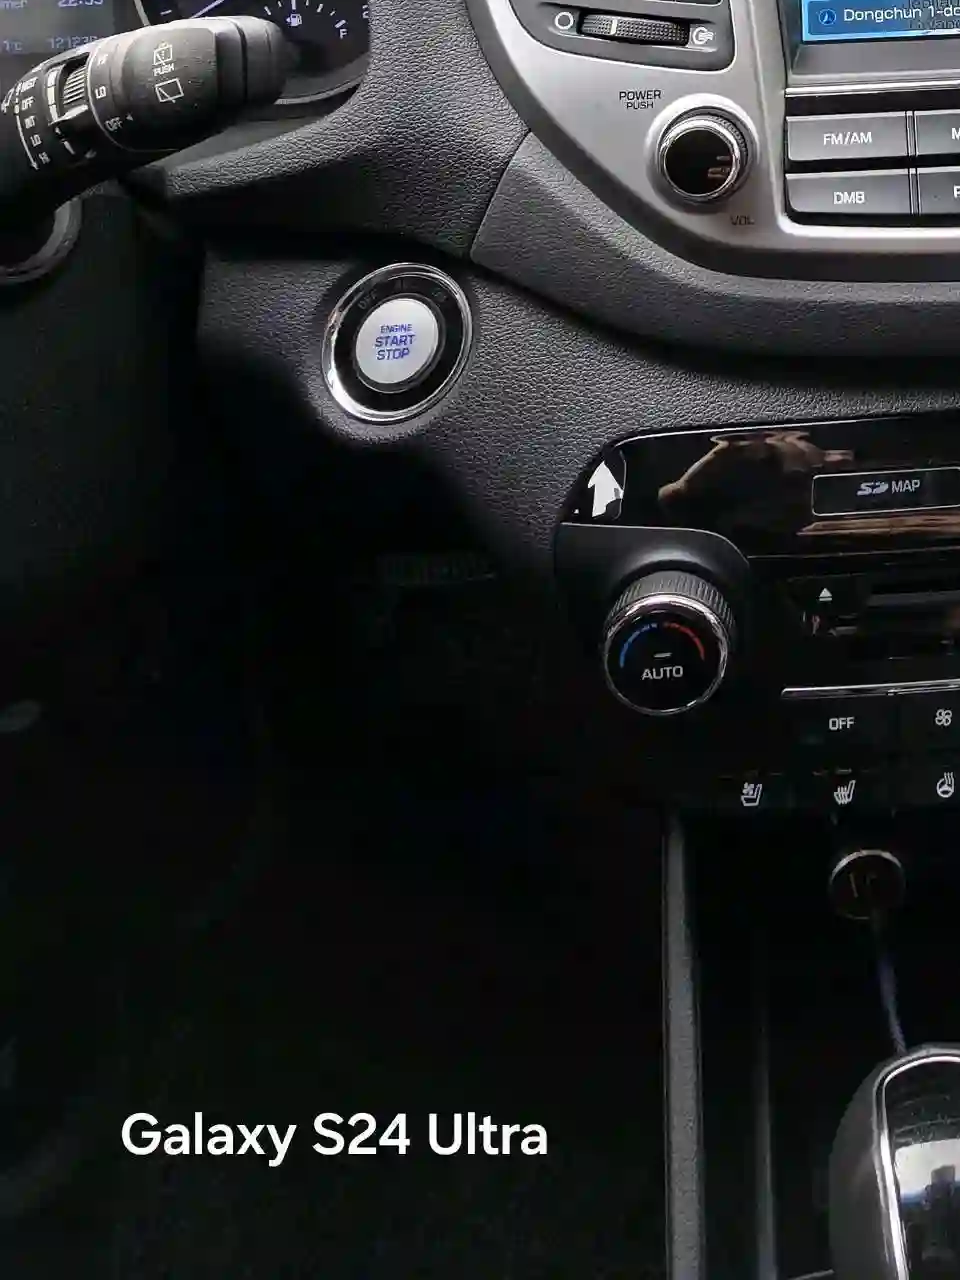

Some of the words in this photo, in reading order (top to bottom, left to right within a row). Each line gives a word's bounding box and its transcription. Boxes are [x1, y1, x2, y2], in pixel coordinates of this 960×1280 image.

[844, 7, 922, 24] Dongchun
[338, 28, 348, 39] F
[619, 89, 662, 102] POWER
[626, 101, 655, 110] PUSH
[823, 131, 873, 146] FM/AM
[833, 191, 866, 205] DMB
[380, 323, 413, 334] ENGINE
[374, 334, 416, 348] START
[376, 347, 411, 361] STOP
[890, 479, 921, 495] MAP
[641, 665, 684, 681] AUTO
[828, 716, 855, 731] OFF
